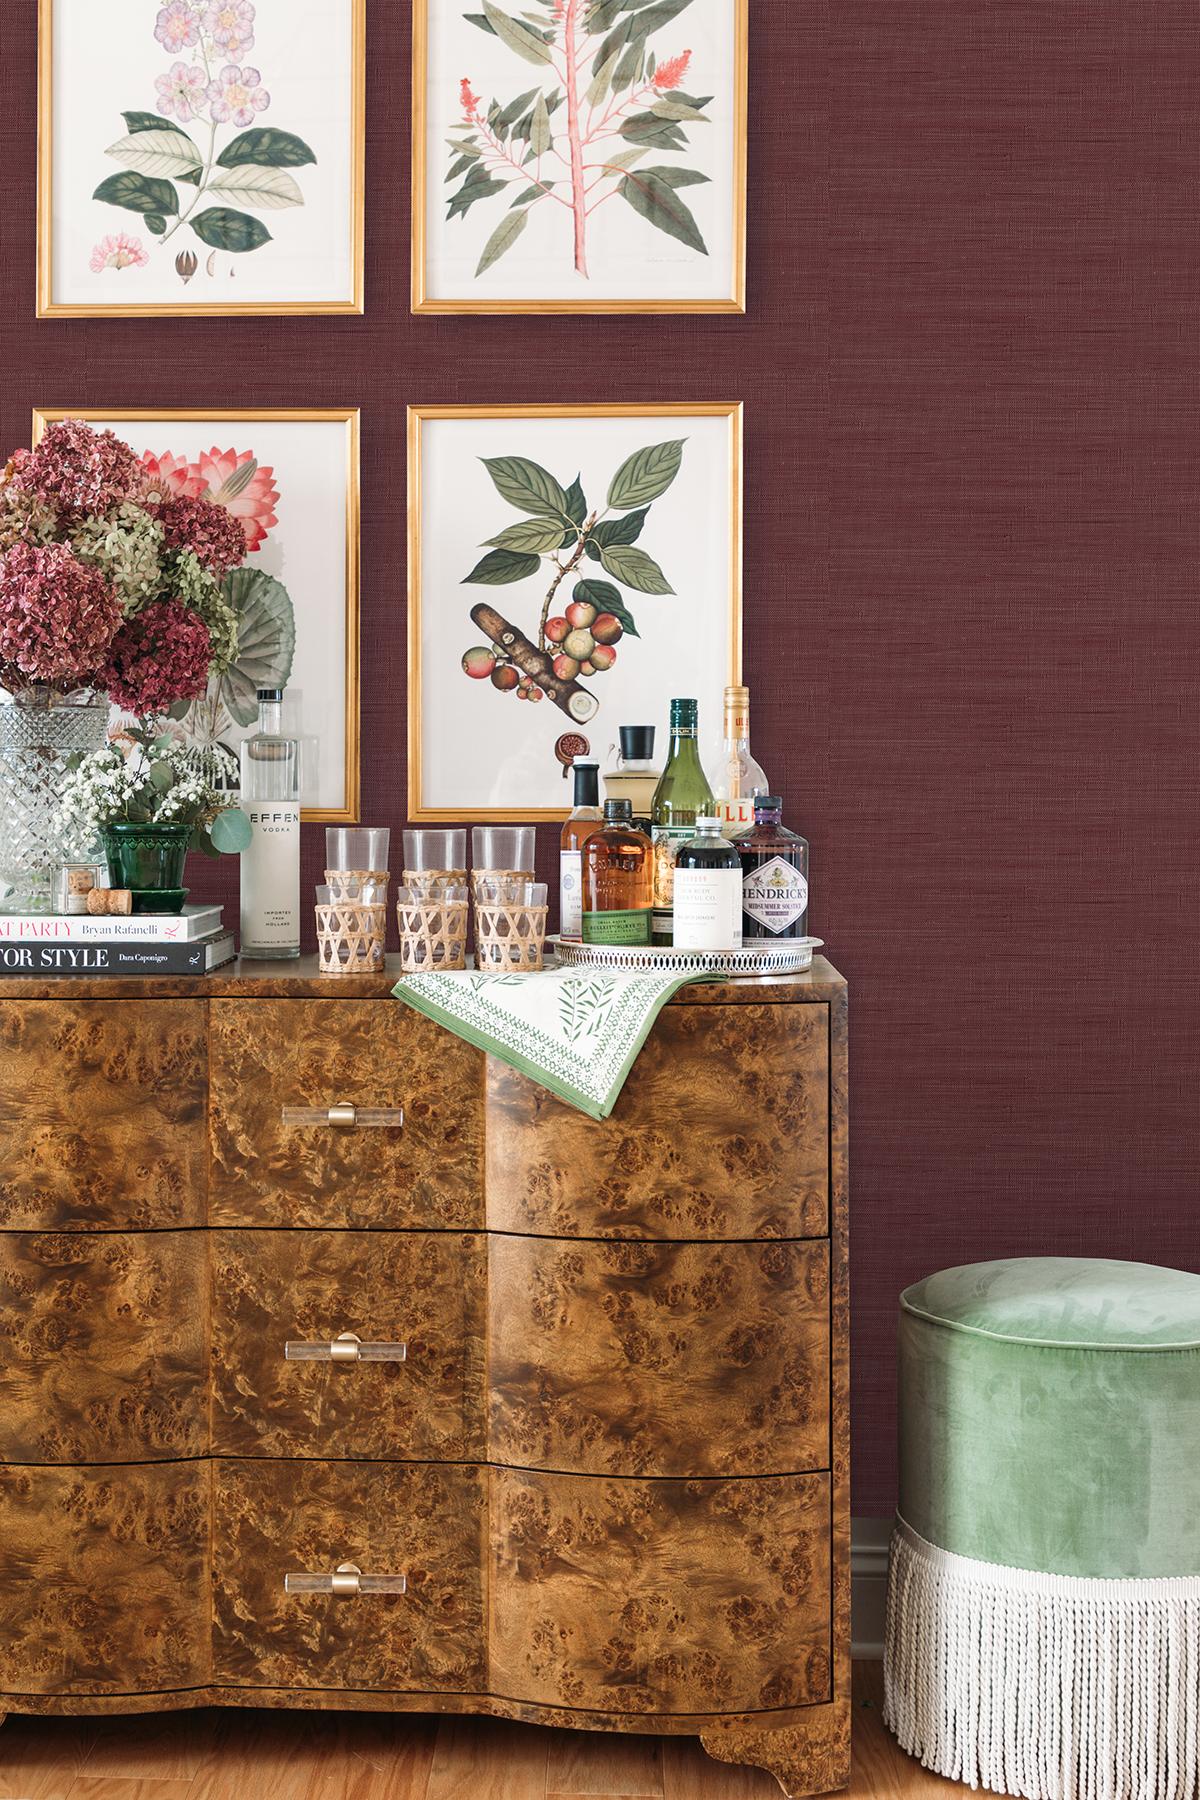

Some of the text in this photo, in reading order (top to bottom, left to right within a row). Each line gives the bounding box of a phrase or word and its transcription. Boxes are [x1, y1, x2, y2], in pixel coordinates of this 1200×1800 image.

[748, 902, 781, 910] MIDSUMMER
[20, 921, 74, 936] PARTY
[82, 924, 112, 938] Bryan
[114, 924, 159, 935] Rafanelli
[0, 947, 34, 967] OR
[40, 947, 110, 967] STYLE
[119, 953, 135, 961] Dara
[135, 953, 168, 963] Caponigro
